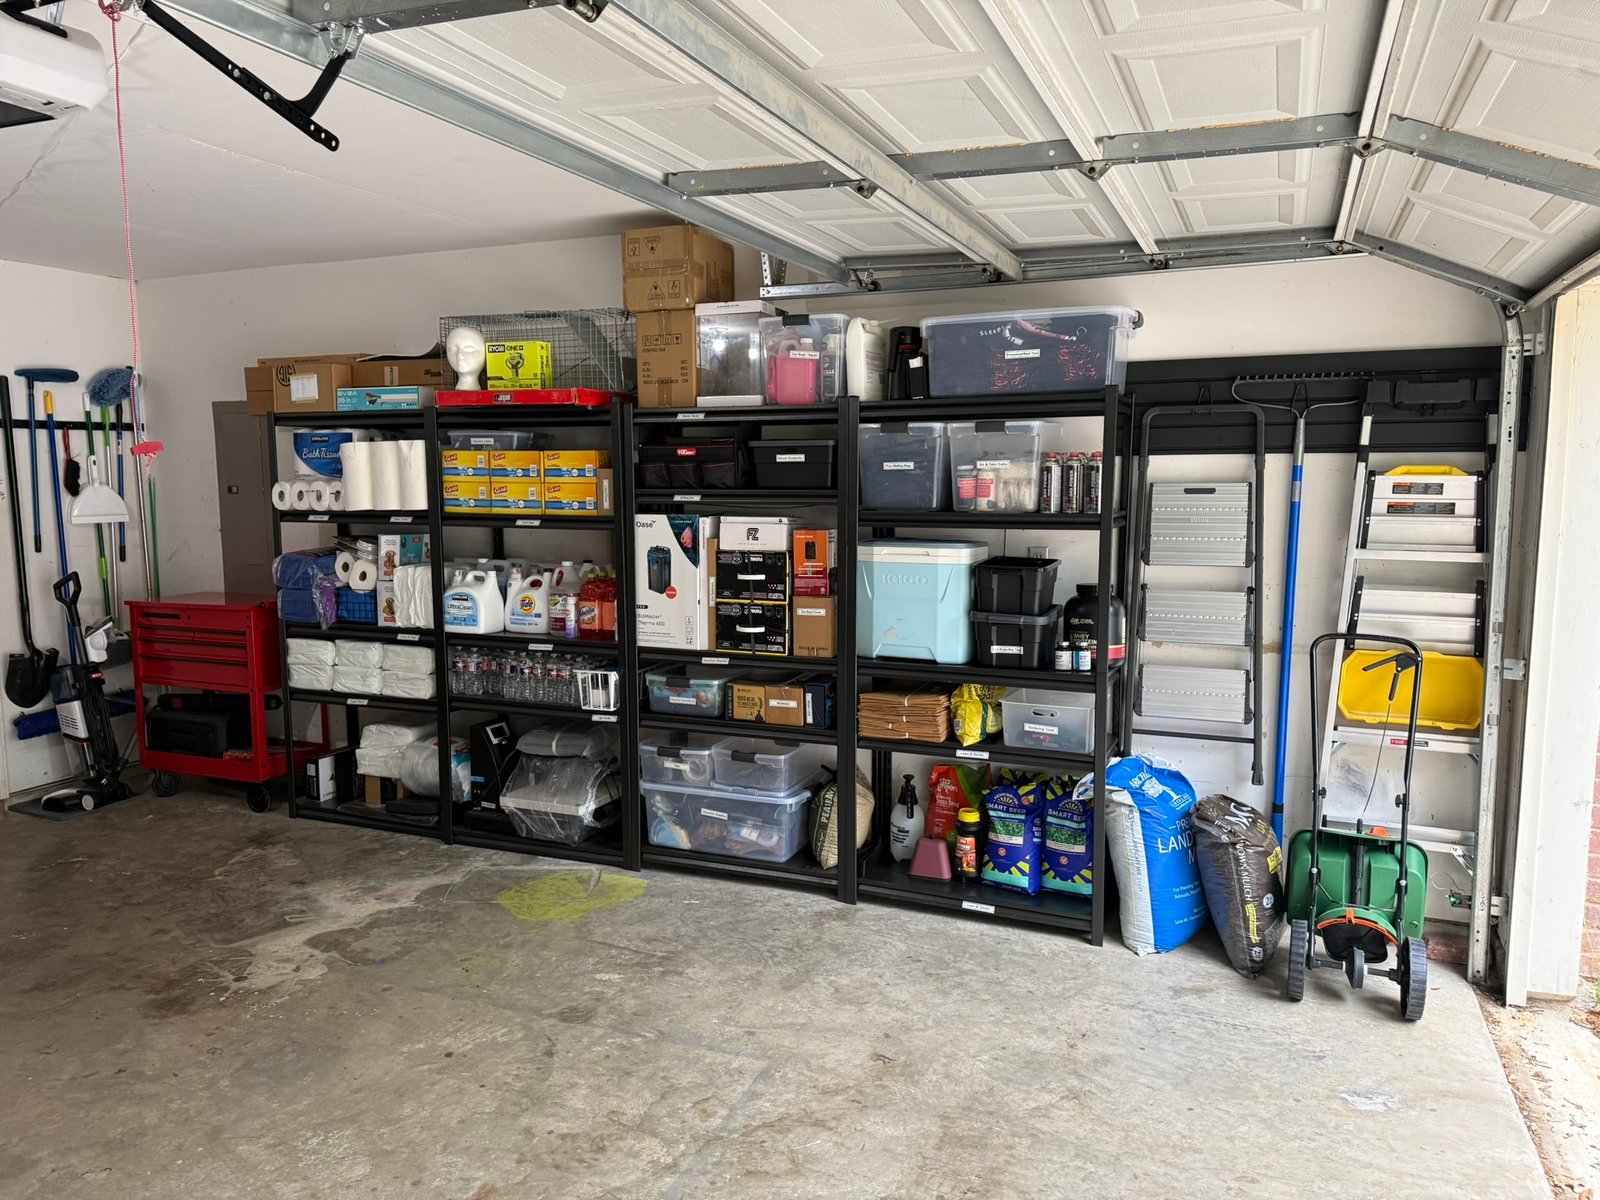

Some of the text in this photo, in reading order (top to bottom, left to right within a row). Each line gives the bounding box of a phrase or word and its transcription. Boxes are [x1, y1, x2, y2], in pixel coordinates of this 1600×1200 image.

[302, 448, 319, 459] Bath
[447, 603, 473, 611] UltraClean
[520, 599, 533, 610] Tide
[1048, 808, 1072, 819] SMART
[1241, 870, 1253, 901] MULCH
